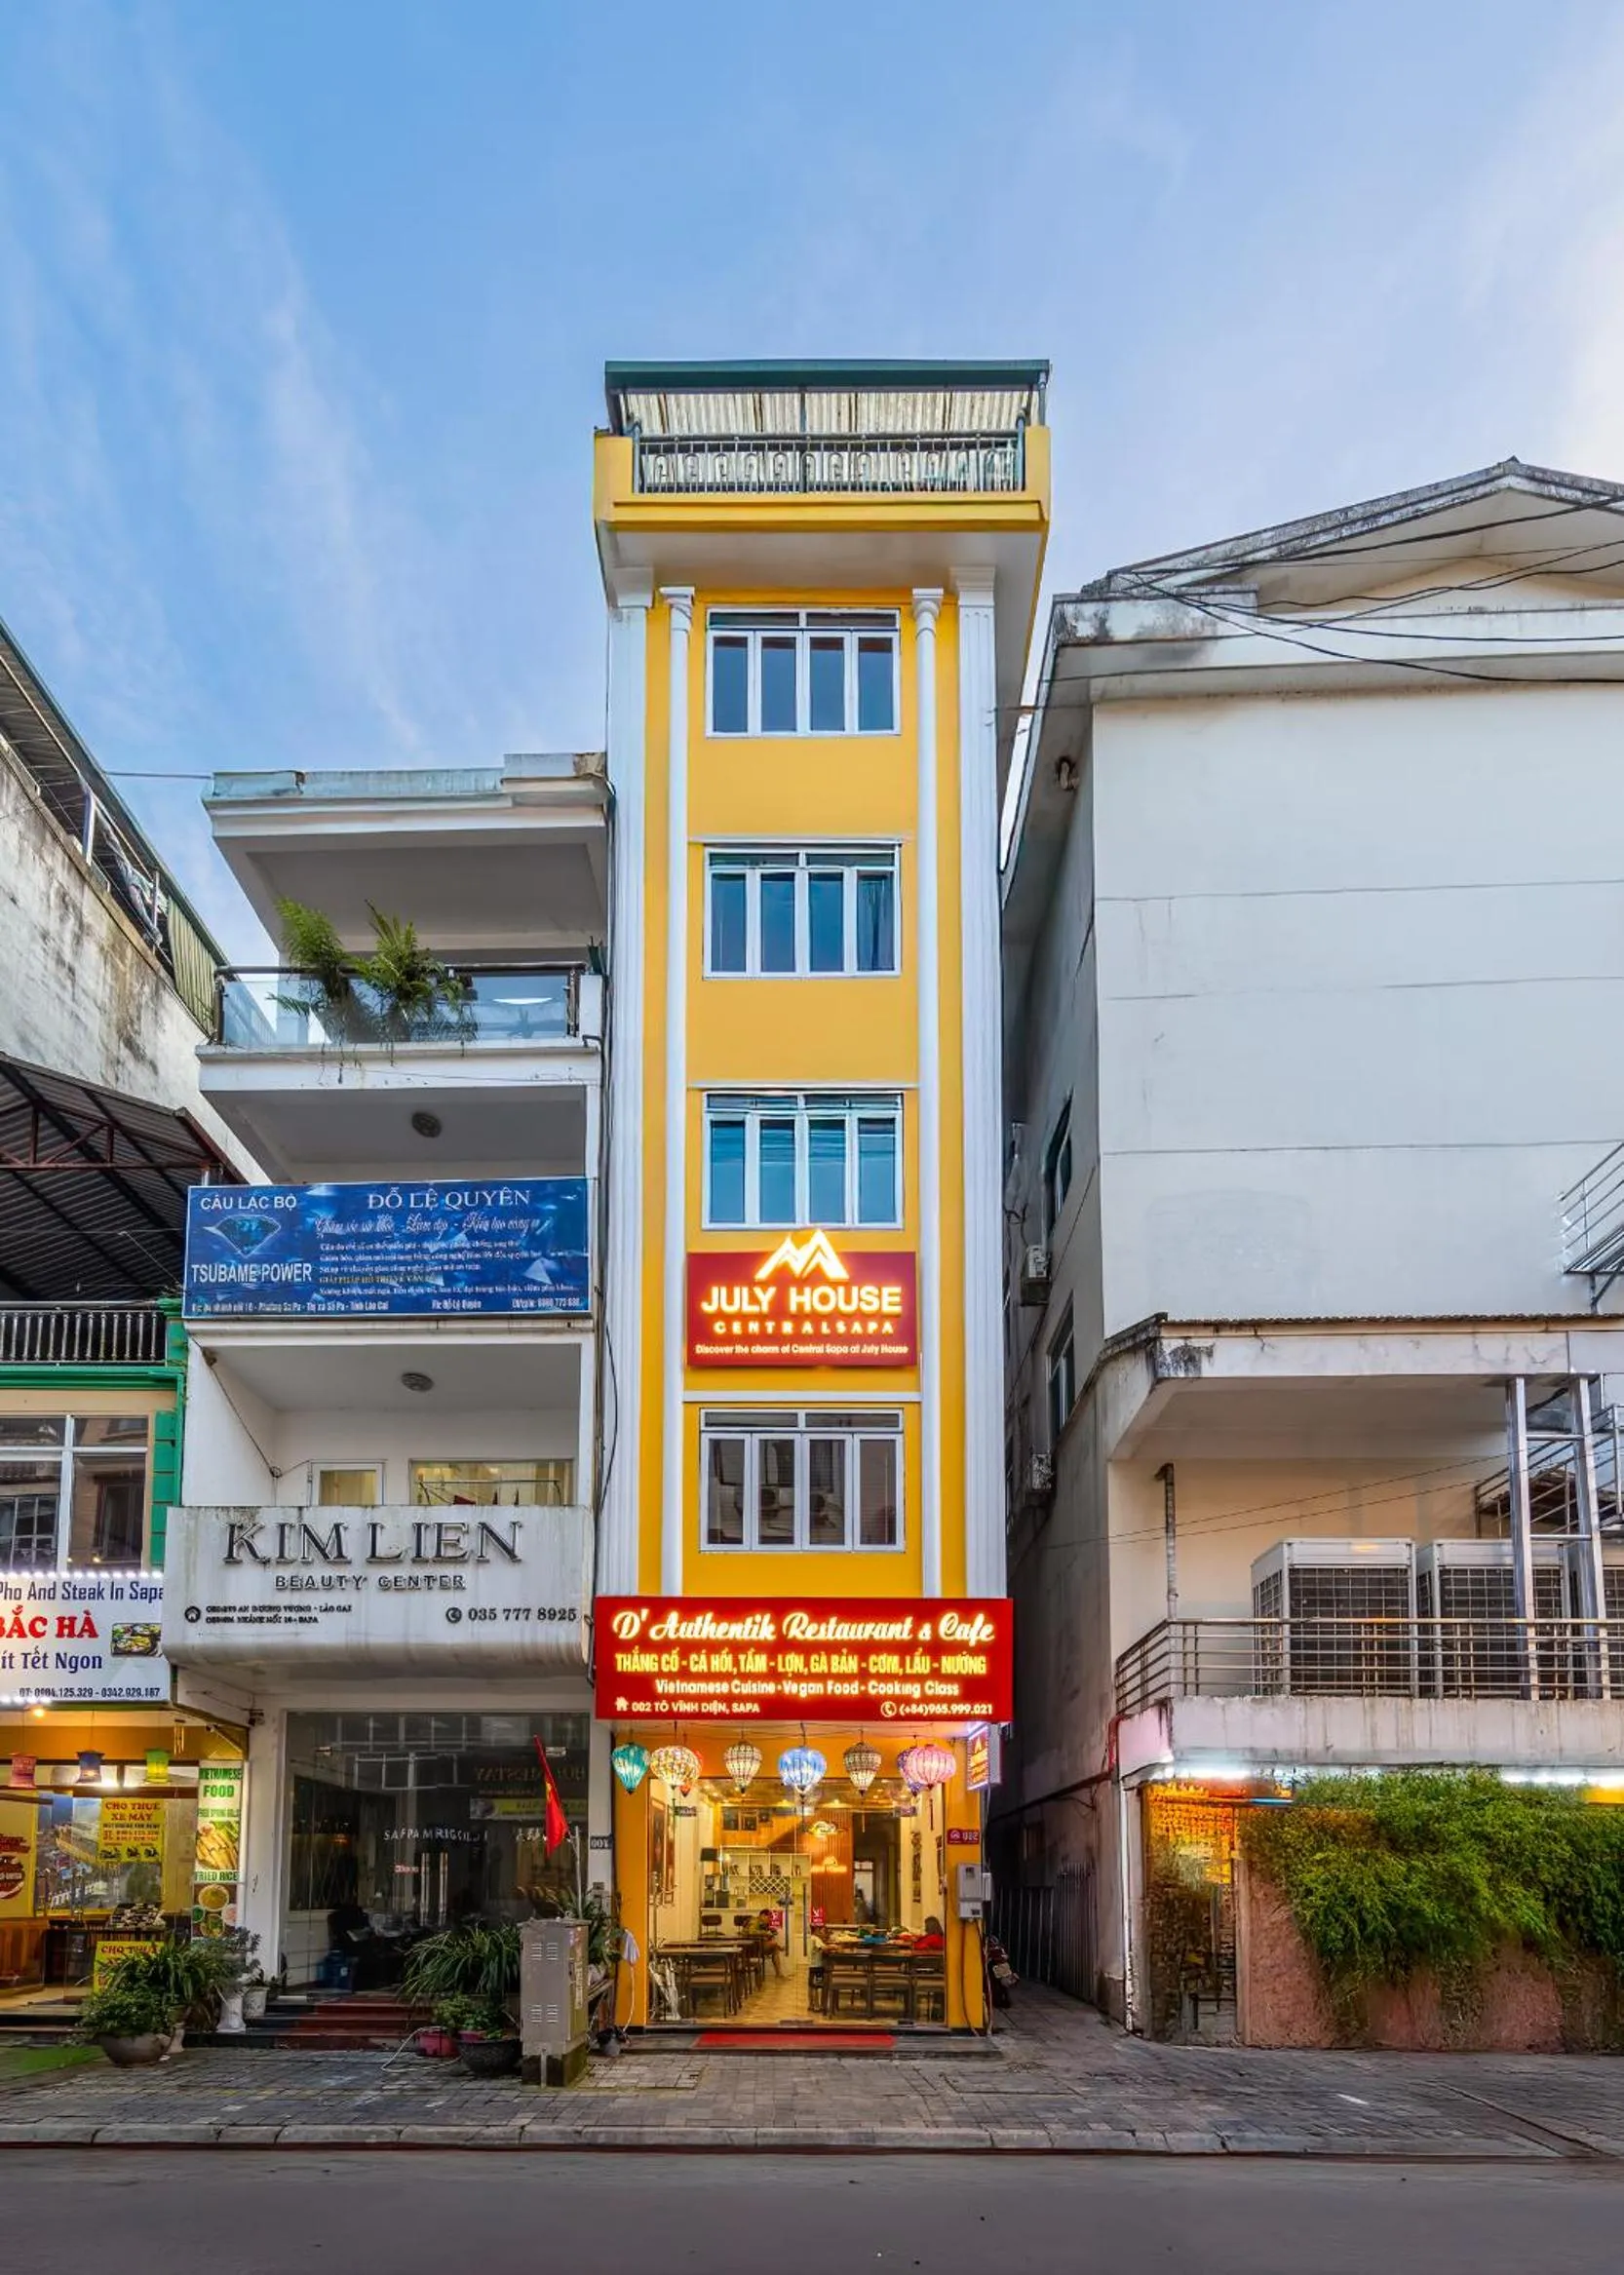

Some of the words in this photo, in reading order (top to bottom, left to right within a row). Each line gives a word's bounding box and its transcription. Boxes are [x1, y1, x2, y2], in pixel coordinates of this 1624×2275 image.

[238, 1196, 269, 1212] LẠC
[368, 1186, 403, 1209] ĐỖ
[409, 1188, 439, 1211] LỆ
[445, 1186, 530, 1211] QUYÊN
[191, 1264, 257, 1283] TSUBAME
[261, 1262, 312, 1282] POWER
[701, 1286, 777, 1314] JULY
[789, 1286, 903, 1314] HOUSE
[861, 1344, 879, 1357] July
[880, 1344, 909, 1355] House
[222, 1522, 352, 1564] KIM
[366, 1521, 524, 1564] LIEN
[27, 1581, 57, 1600] And
[61, 1581, 105, 1600] Steak
[110, 1581, 124, 1600] In
[275, 1574, 367, 1591] BEAUTY
[377, 1574, 468, 1591] CENTER
[56, 1609, 99, 1639] HÀ
[468, 1607, 497, 1621] 035
[503, 1607, 532, 1622] 777
[537, 1607, 577, 1622] 8925
[783, 1612, 912, 1641] Restaurant
[917, 1624, 932, 1640] &
[939, 1612, 995, 1645] Cafe
[20, 1645, 49, 1669] Tết
[56, 1653, 102, 1674] Ngon
[689, 1649, 708, 1673] CÁ
[810, 1651, 829, 1674] GÀ
[655, 1678, 730, 1694] Vietnamese
[731, 1679, 776, 1694] Cuisine
[782, 1680, 824, 1698] Vegan
[828, 1680, 860, 1695] Food
[868, 1680, 921, 1698] Cooking
[925, 1680, 959, 1695] Class
[632, 1701, 652, 1713] 002
[731, 1702, 760, 1713] SAPA
[203, 1785, 235, 1798] FOOD
[219, 1870, 240, 1881] RICE
